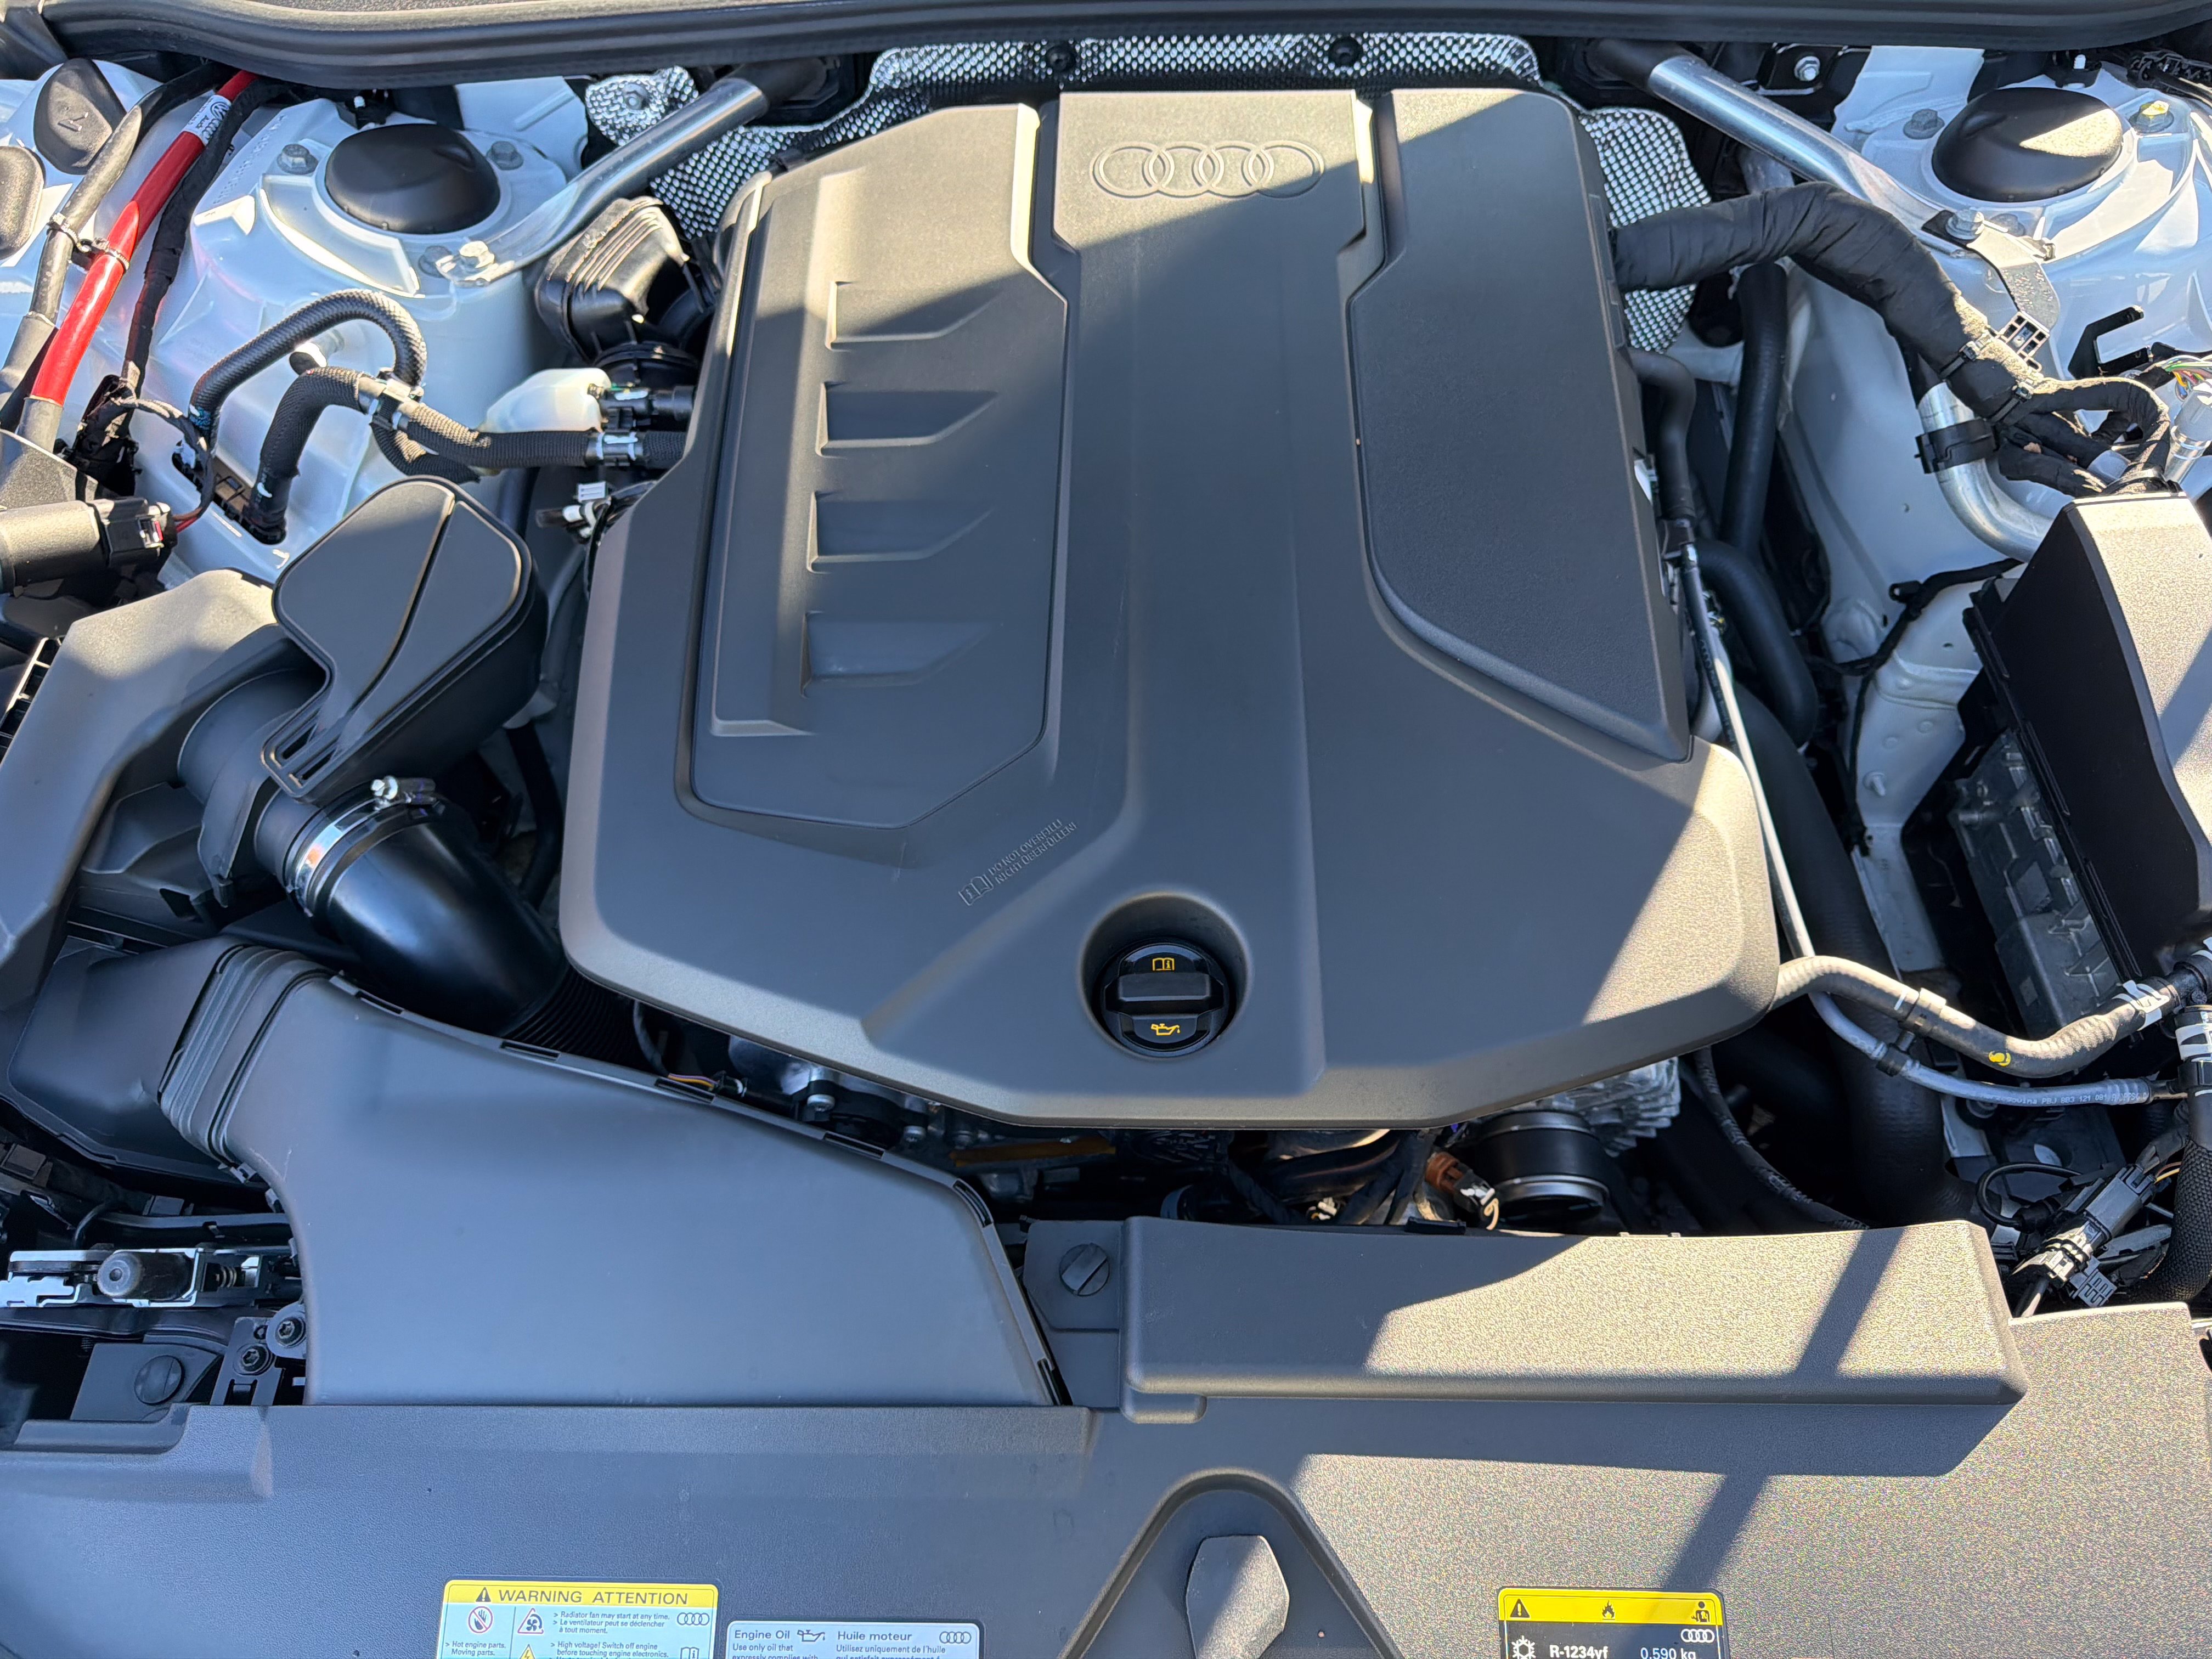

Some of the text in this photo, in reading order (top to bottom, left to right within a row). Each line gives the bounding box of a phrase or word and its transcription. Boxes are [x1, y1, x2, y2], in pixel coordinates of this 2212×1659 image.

[988, 863, 1002, 876] DO
[1002, 850, 1020, 866] NOT
[995, 861, 1022, 884] NICHT
[499, 1589, 688, 1605] WARNING ATTENTION
[735, 1629, 790, 1640] Engine Oil
[837, 1631, 912, 1641] Huile moteur
[557, 1641, 573, 1650] High
[574, 1641, 601, 1650] voltage!
[749, 1643, 766, 1653] only
[767, 1643, 776, 1651] oil
[778, 1644, 793, 1652] that
[865, 1645, 910, 1654] uniquement
[451, 1649, 476, 1657] Moving
[579, 1650, 607, 1658] touching
[1549, 1645, 1609, 1659] R-1234yf
[1640, 1647, 1677, 1659] 0.590
